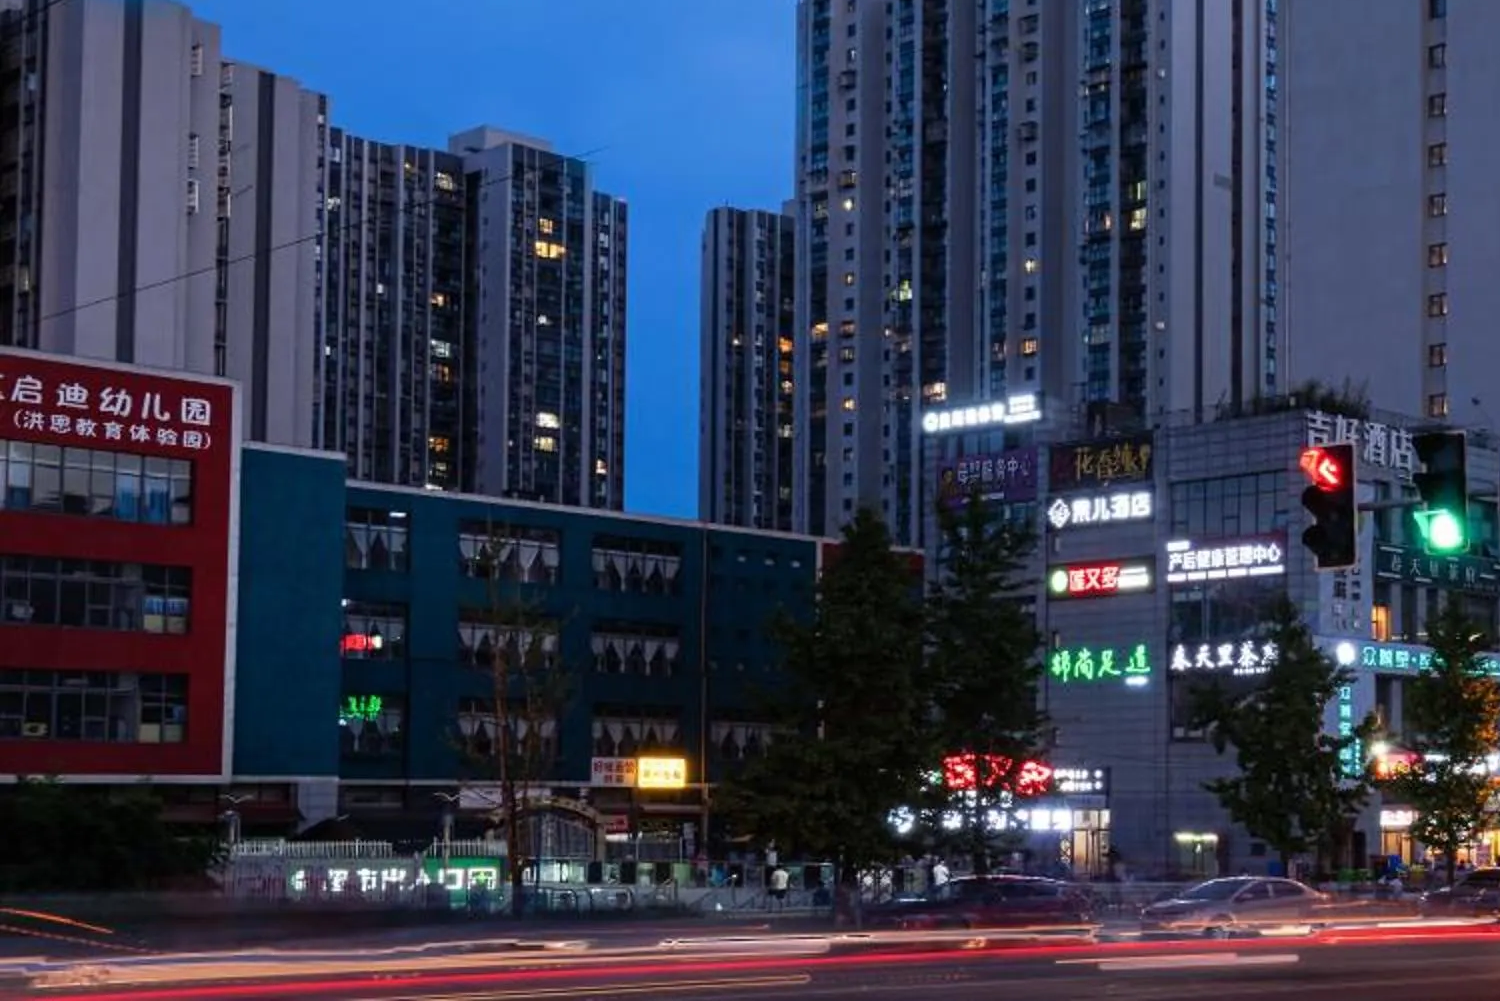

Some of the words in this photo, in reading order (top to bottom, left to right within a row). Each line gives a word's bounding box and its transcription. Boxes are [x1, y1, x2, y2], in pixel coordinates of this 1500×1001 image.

[0, 373, 211, 426] 启迪幼儿园
